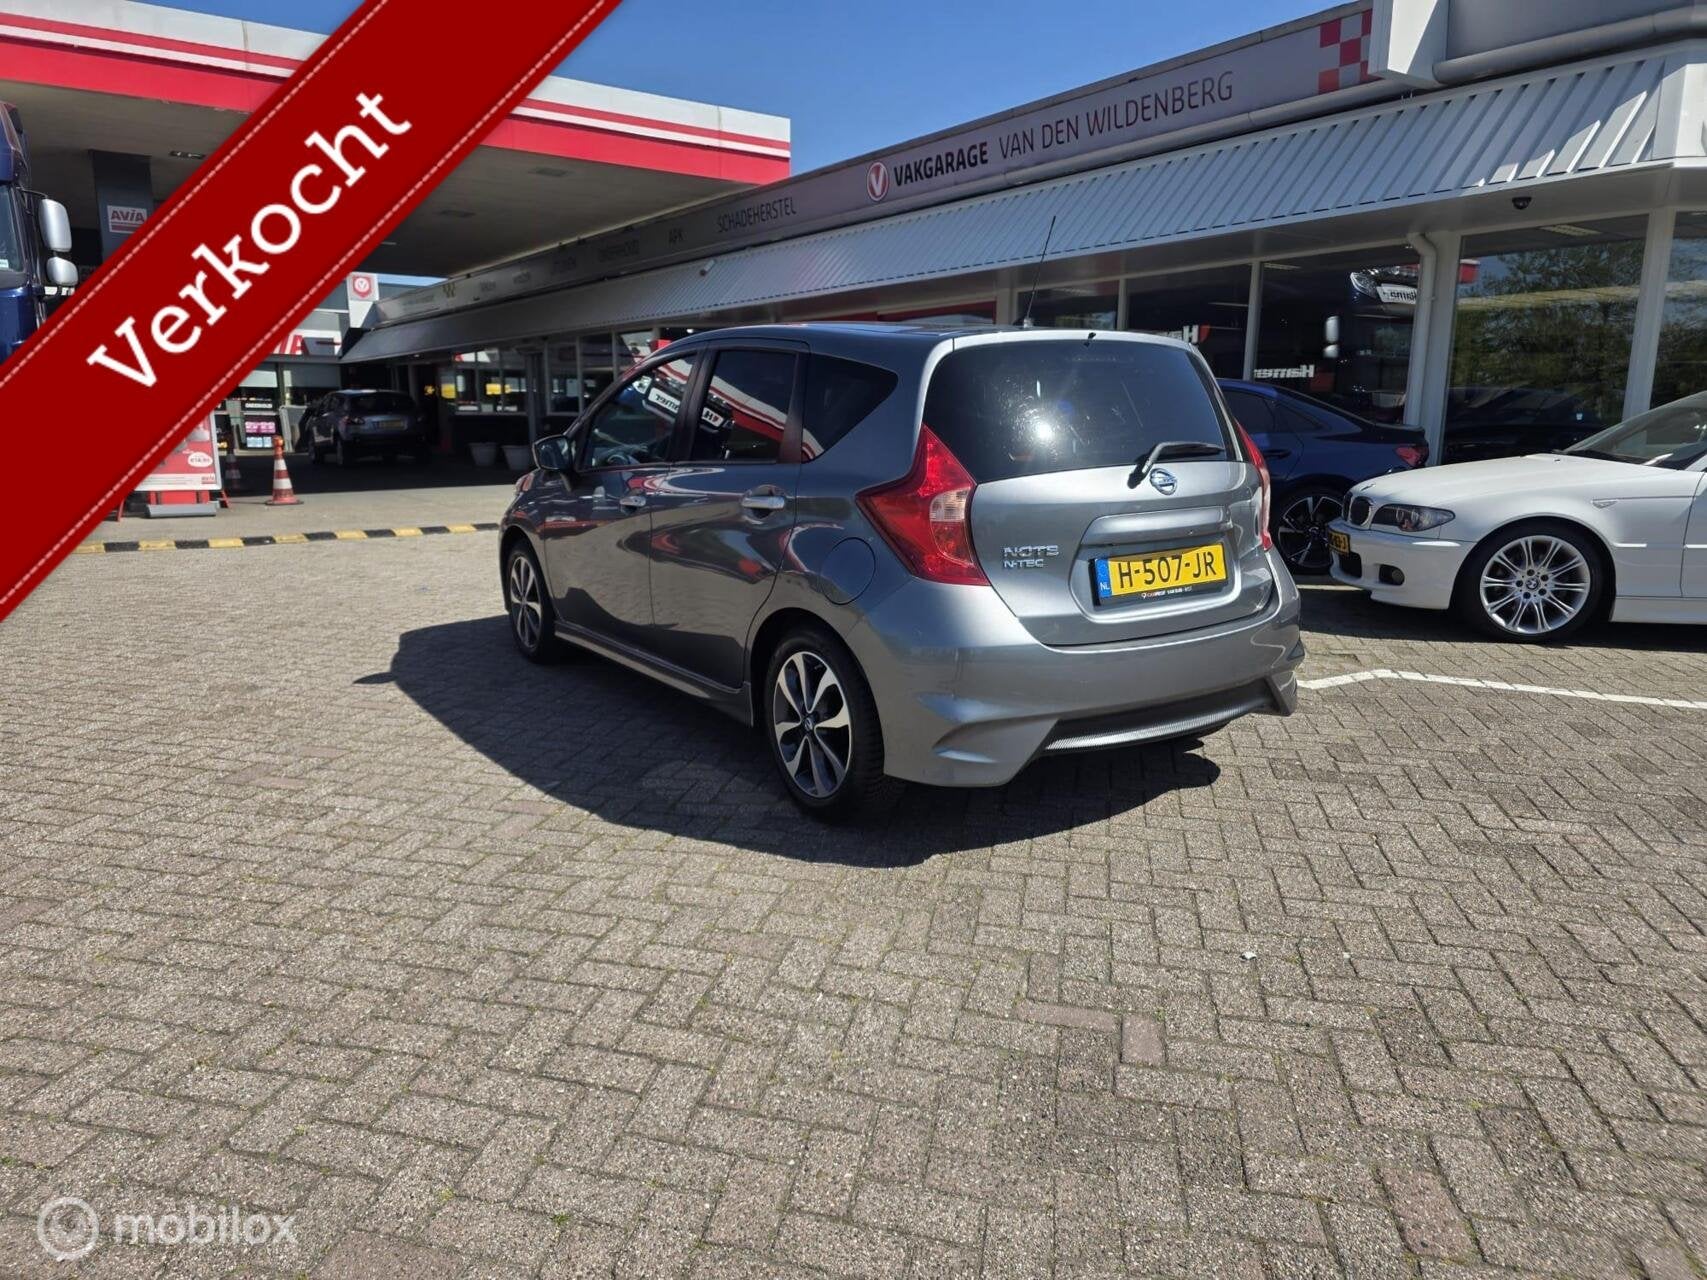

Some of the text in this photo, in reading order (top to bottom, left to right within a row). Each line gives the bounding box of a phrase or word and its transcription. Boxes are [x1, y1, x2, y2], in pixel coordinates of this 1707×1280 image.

[894, 71, 1233, 187] VAKGARAGE VAN DEN WILDENBERG
[111, 209, 146, 222] AVIA
[717, 197, 797, 233] SCHADEHERSTEL
[1004, 558, 1044, 568] N-TEC
[1100, 551, 1216, 591] NL H-507-JR
